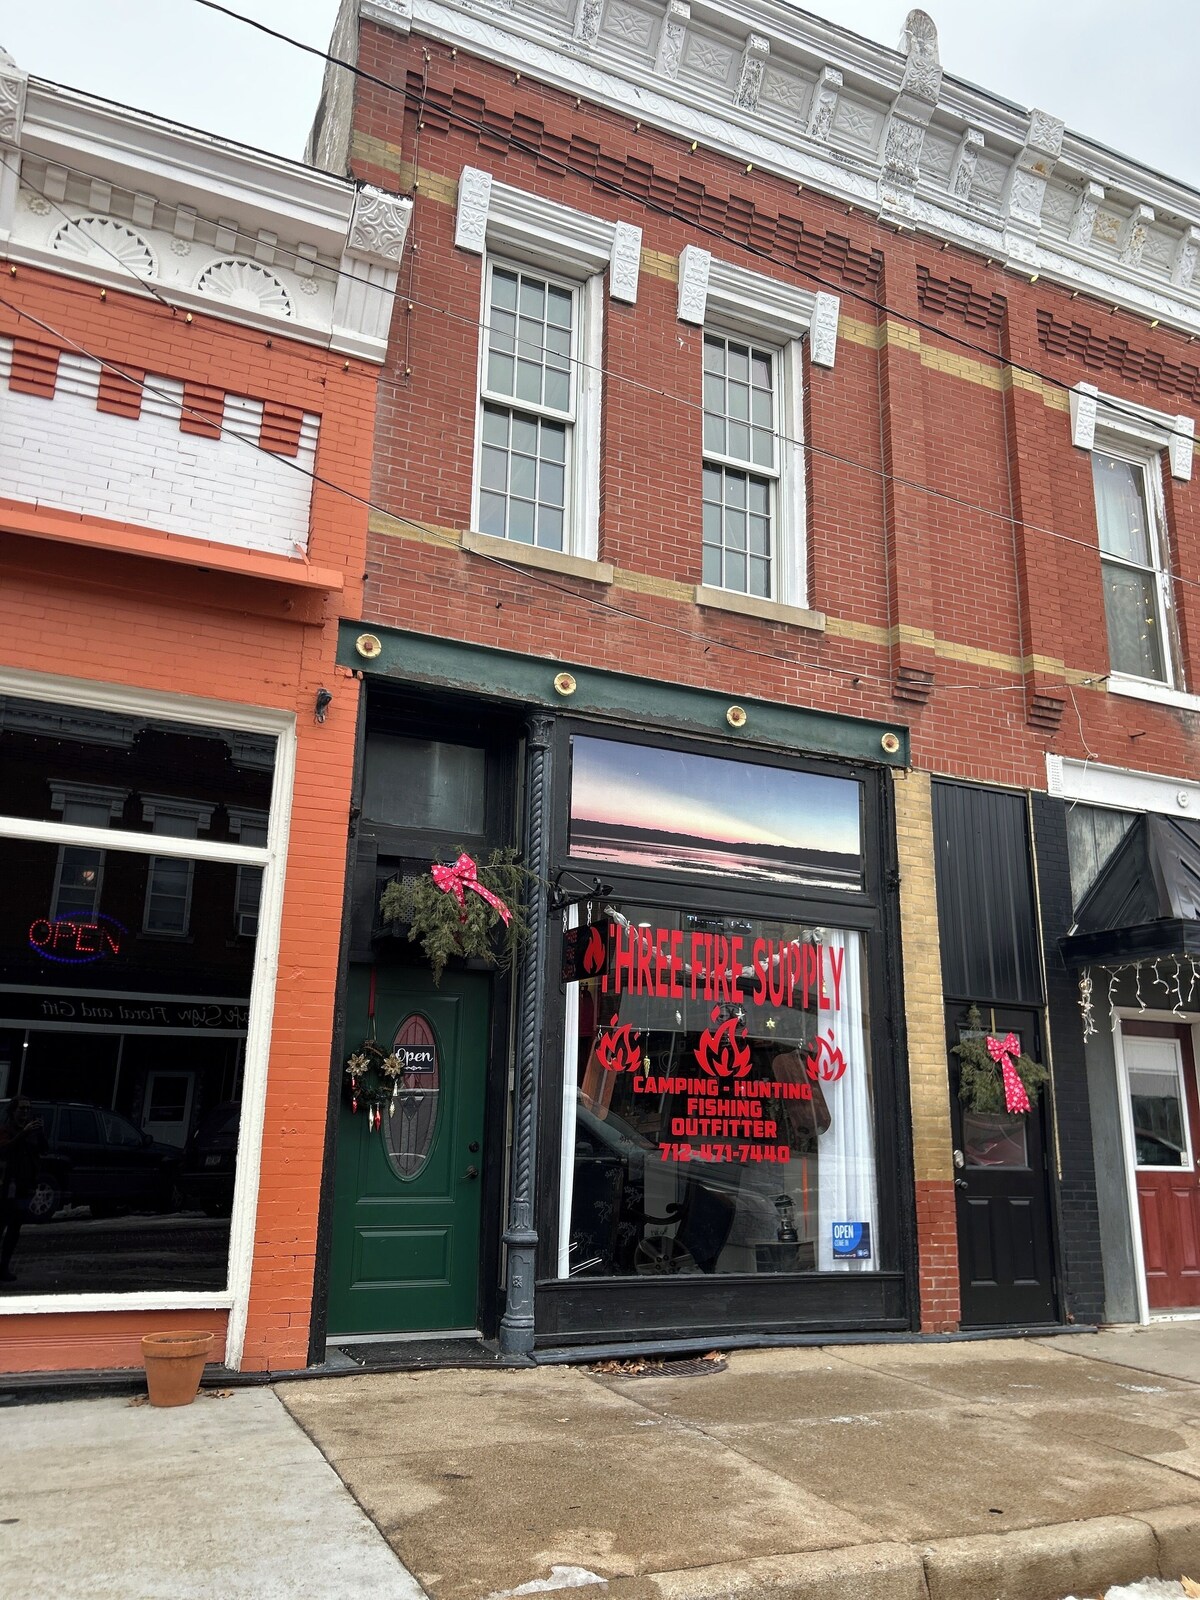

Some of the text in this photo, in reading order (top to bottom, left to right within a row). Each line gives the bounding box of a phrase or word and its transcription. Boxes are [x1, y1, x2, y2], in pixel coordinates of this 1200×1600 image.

[29, 919, 119, 954] OPEN
[691, 931, 744, 1004] FIRE
[753, 937, 844, 1011] SUPPLY
[395, 1047, 434, 1066] Open
[633, 1076, 719, 1097] CAMPING
[734, 1080, 813, 1101] HUNTING
[687, 1098, 763, 1118] FISHING
[671, 1117, 778, 1139] OUTFITTER
[658, 1142, 791, 1164] 712-471-7440
[834, 1224, 854, 1239] OPEN
